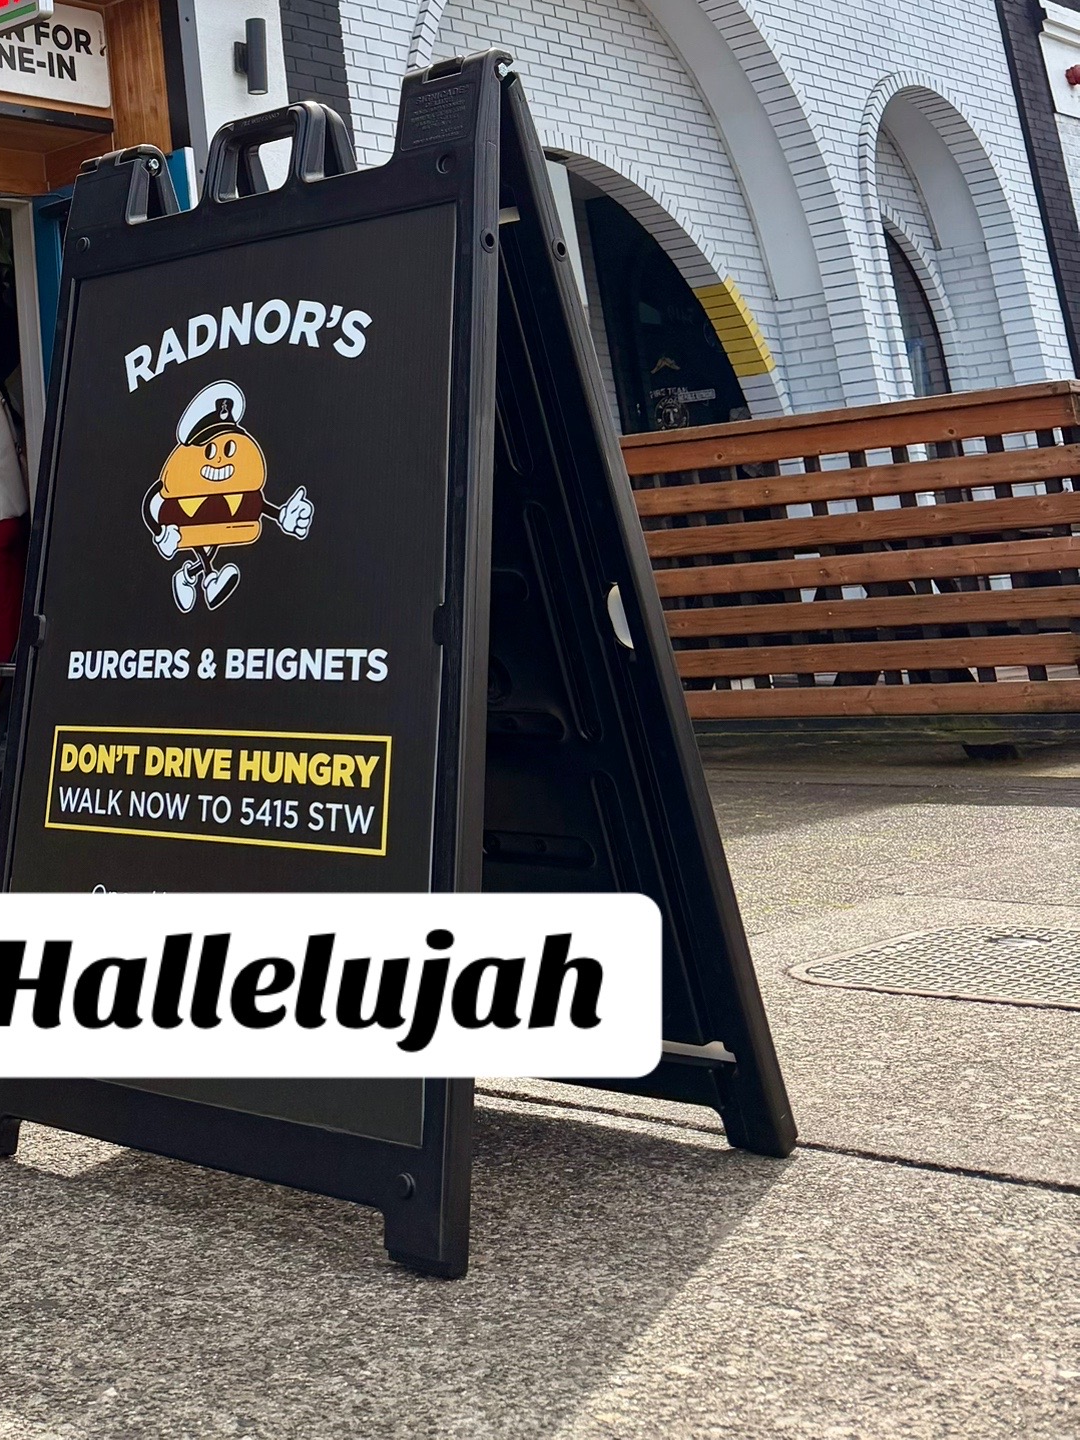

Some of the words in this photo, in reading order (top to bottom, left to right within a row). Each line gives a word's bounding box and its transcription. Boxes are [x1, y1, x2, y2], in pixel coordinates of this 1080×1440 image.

[34, 22, 93, 56] FOR
[125, 299, 373, 392] RADNOR'S
[67, 649, 190, 680] BURGERS
[197, 649, 217, 679] &
[225, 648, 389, 682] BEIGNETS
[61, 743, 140, 775] DON'T
[145, 746, 232, 779] DRIVE
[238, 750, 380, 788] HUNGRY
[59, 786, 122, 816] WALK
[129, 790, 190, 820] NOW
[198, 794, 232, 824] TO
[240, 797, 299, 829] 5415
[308, 802, 375, 835] STW
